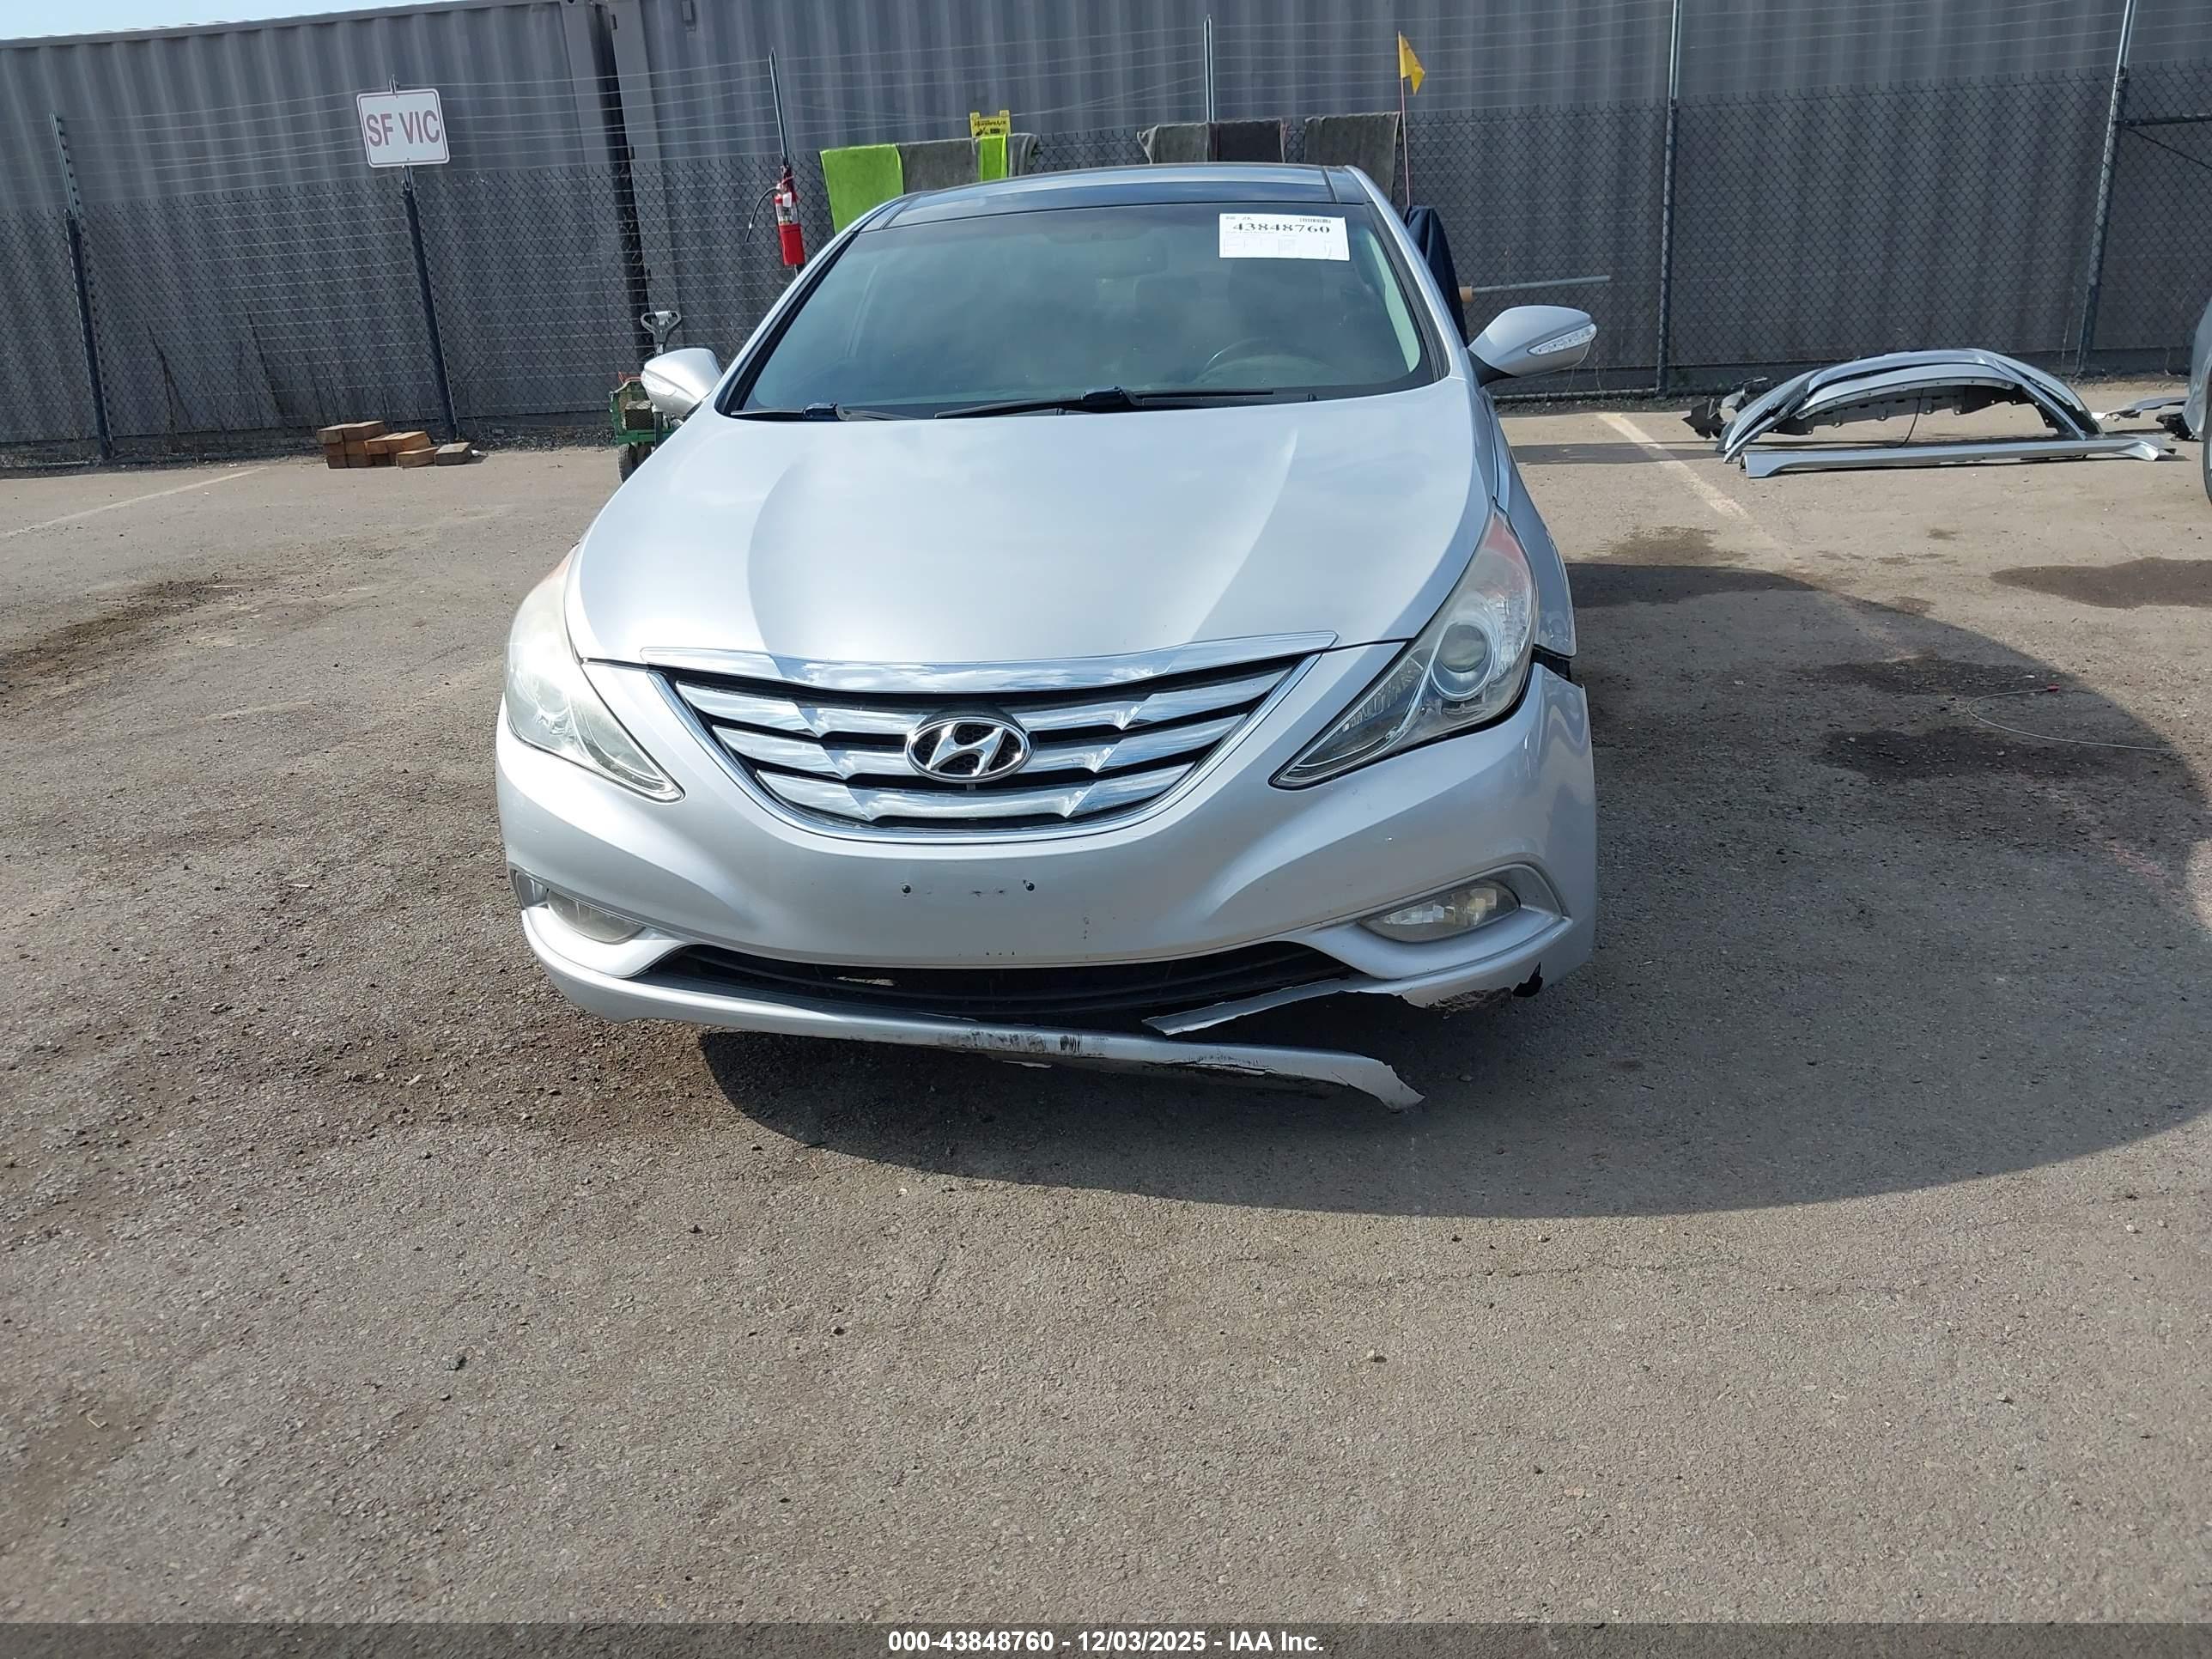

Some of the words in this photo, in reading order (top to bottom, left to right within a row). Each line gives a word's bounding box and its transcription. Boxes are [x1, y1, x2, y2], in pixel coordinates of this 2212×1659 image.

[366, 113, 393, 147] SF
[398, 110, 441, 144] VIC
[1232, 222, 1330, 234] 43848760
